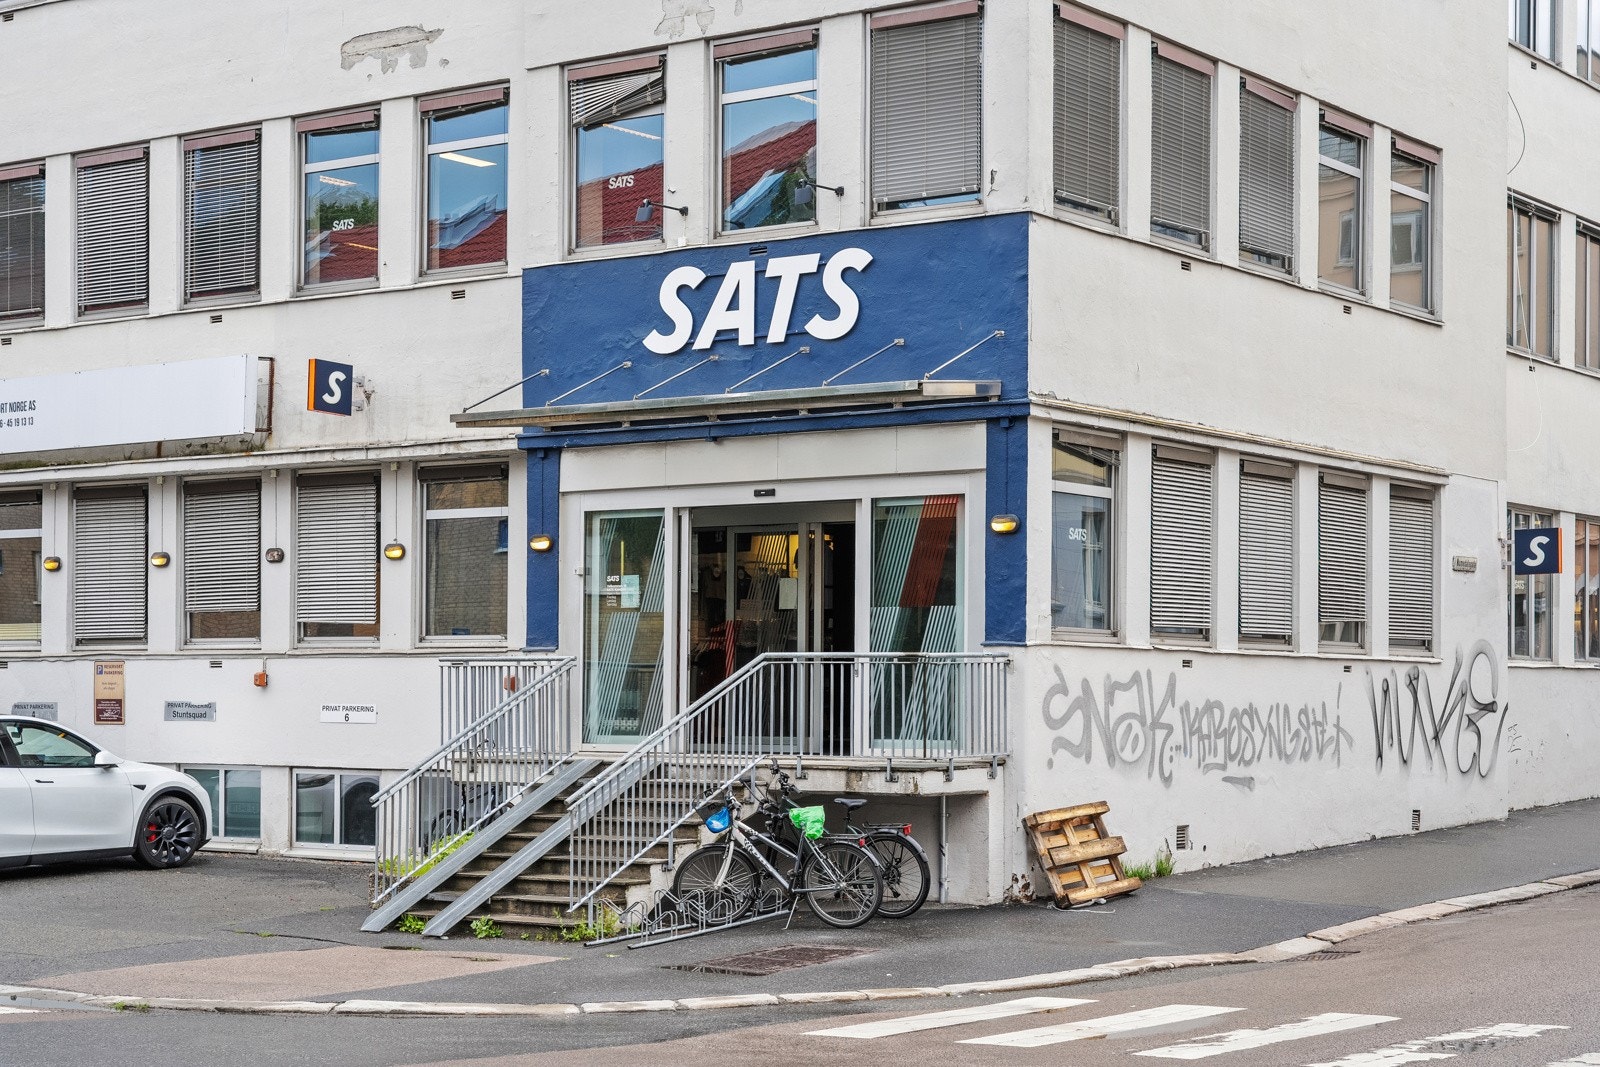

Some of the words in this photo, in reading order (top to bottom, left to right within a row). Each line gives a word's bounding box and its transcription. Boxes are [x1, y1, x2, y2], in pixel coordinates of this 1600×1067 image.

[608, 175, 634, 189] SATS
[332, 218, 355, 231] SATS
[642, 247, 874, 355] SATS
[322, 371, 347, 405] S
[9, 401, 27, 412] NORGE
[29, 400, 36, 410] AS
[7, 419, 13, 427] 45
[14, 418, 20, 426] 19
[21, 417, 27, 426] 13
[28, 417, 34, 425] 13
[1068, 527, 1087, 541] SATS
[1522, 535, 1551, 567] S
[172, 710, 207, 719] Stuntsquad
[344, 713, 350, 721] 6
